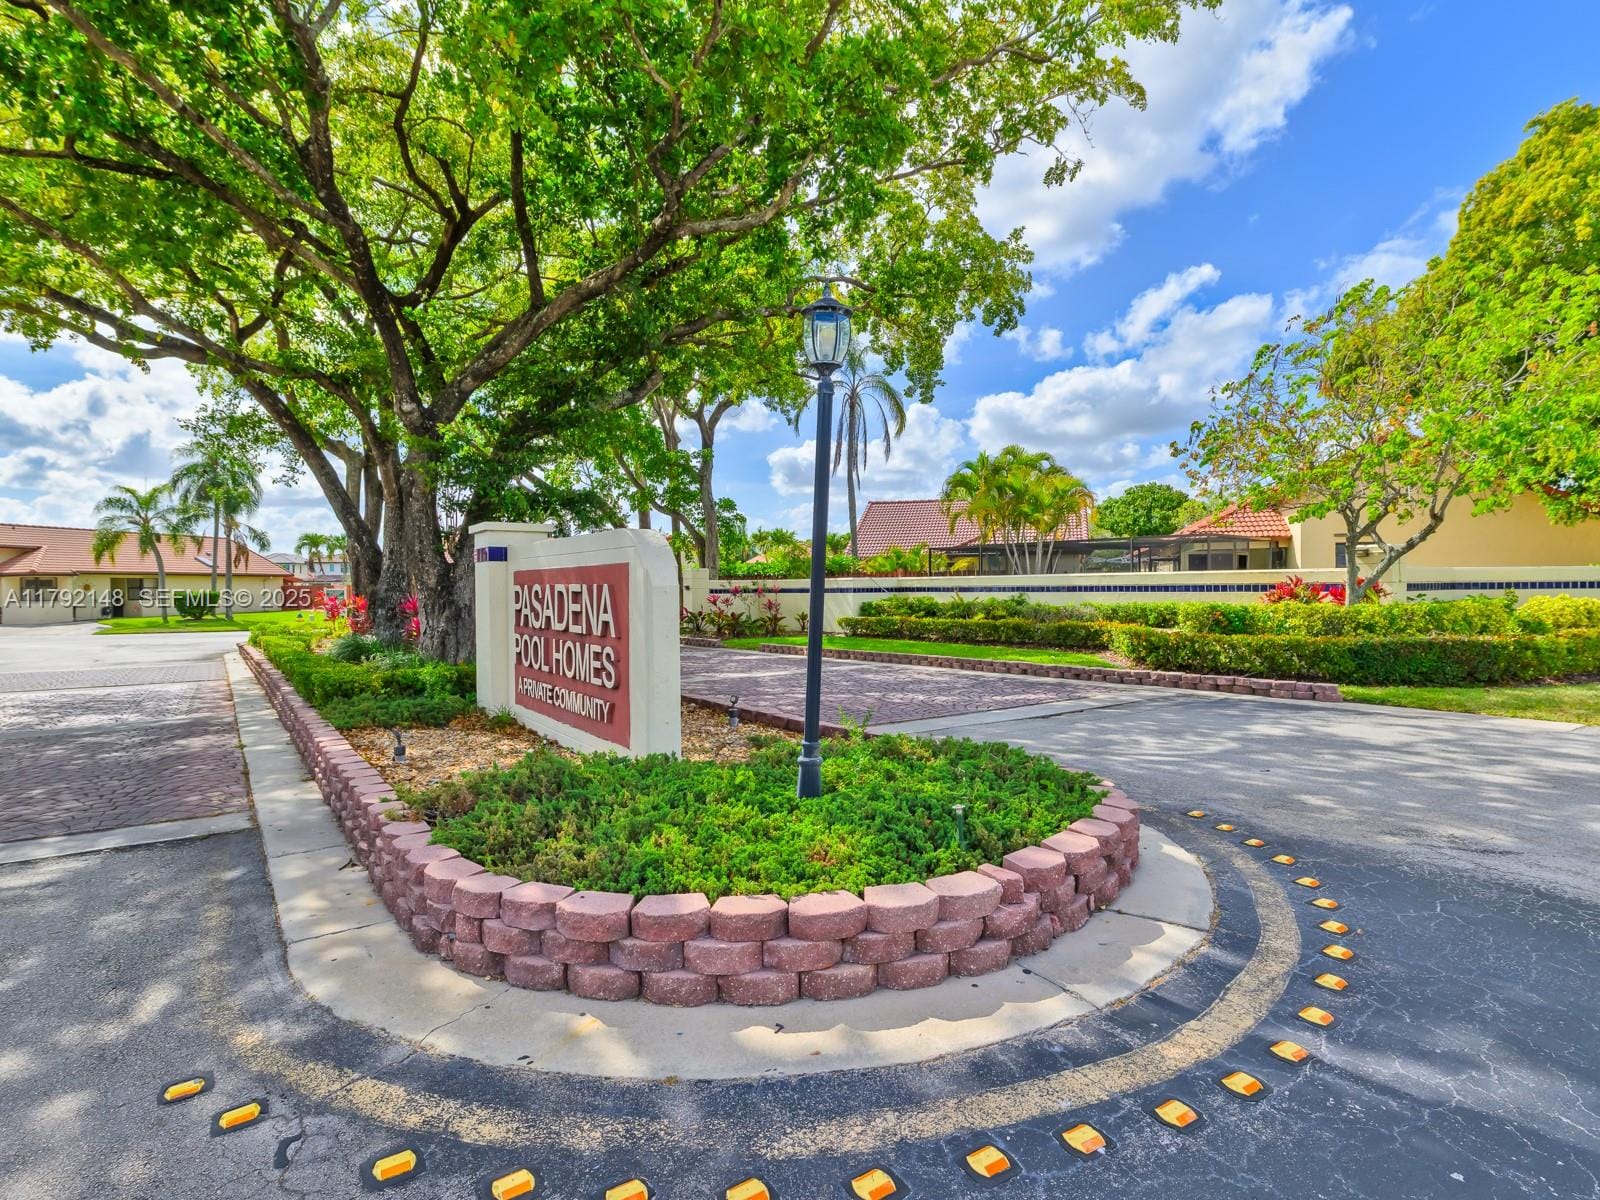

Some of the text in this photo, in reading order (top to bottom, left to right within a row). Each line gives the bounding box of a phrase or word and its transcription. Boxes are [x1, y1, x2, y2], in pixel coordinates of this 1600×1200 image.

[513, 583, 616, 638] PASADENA
[513, 633, 616, 689] POOL HOMES
[518, 676, 611, 724] A PRIVATE COMMUNITY
